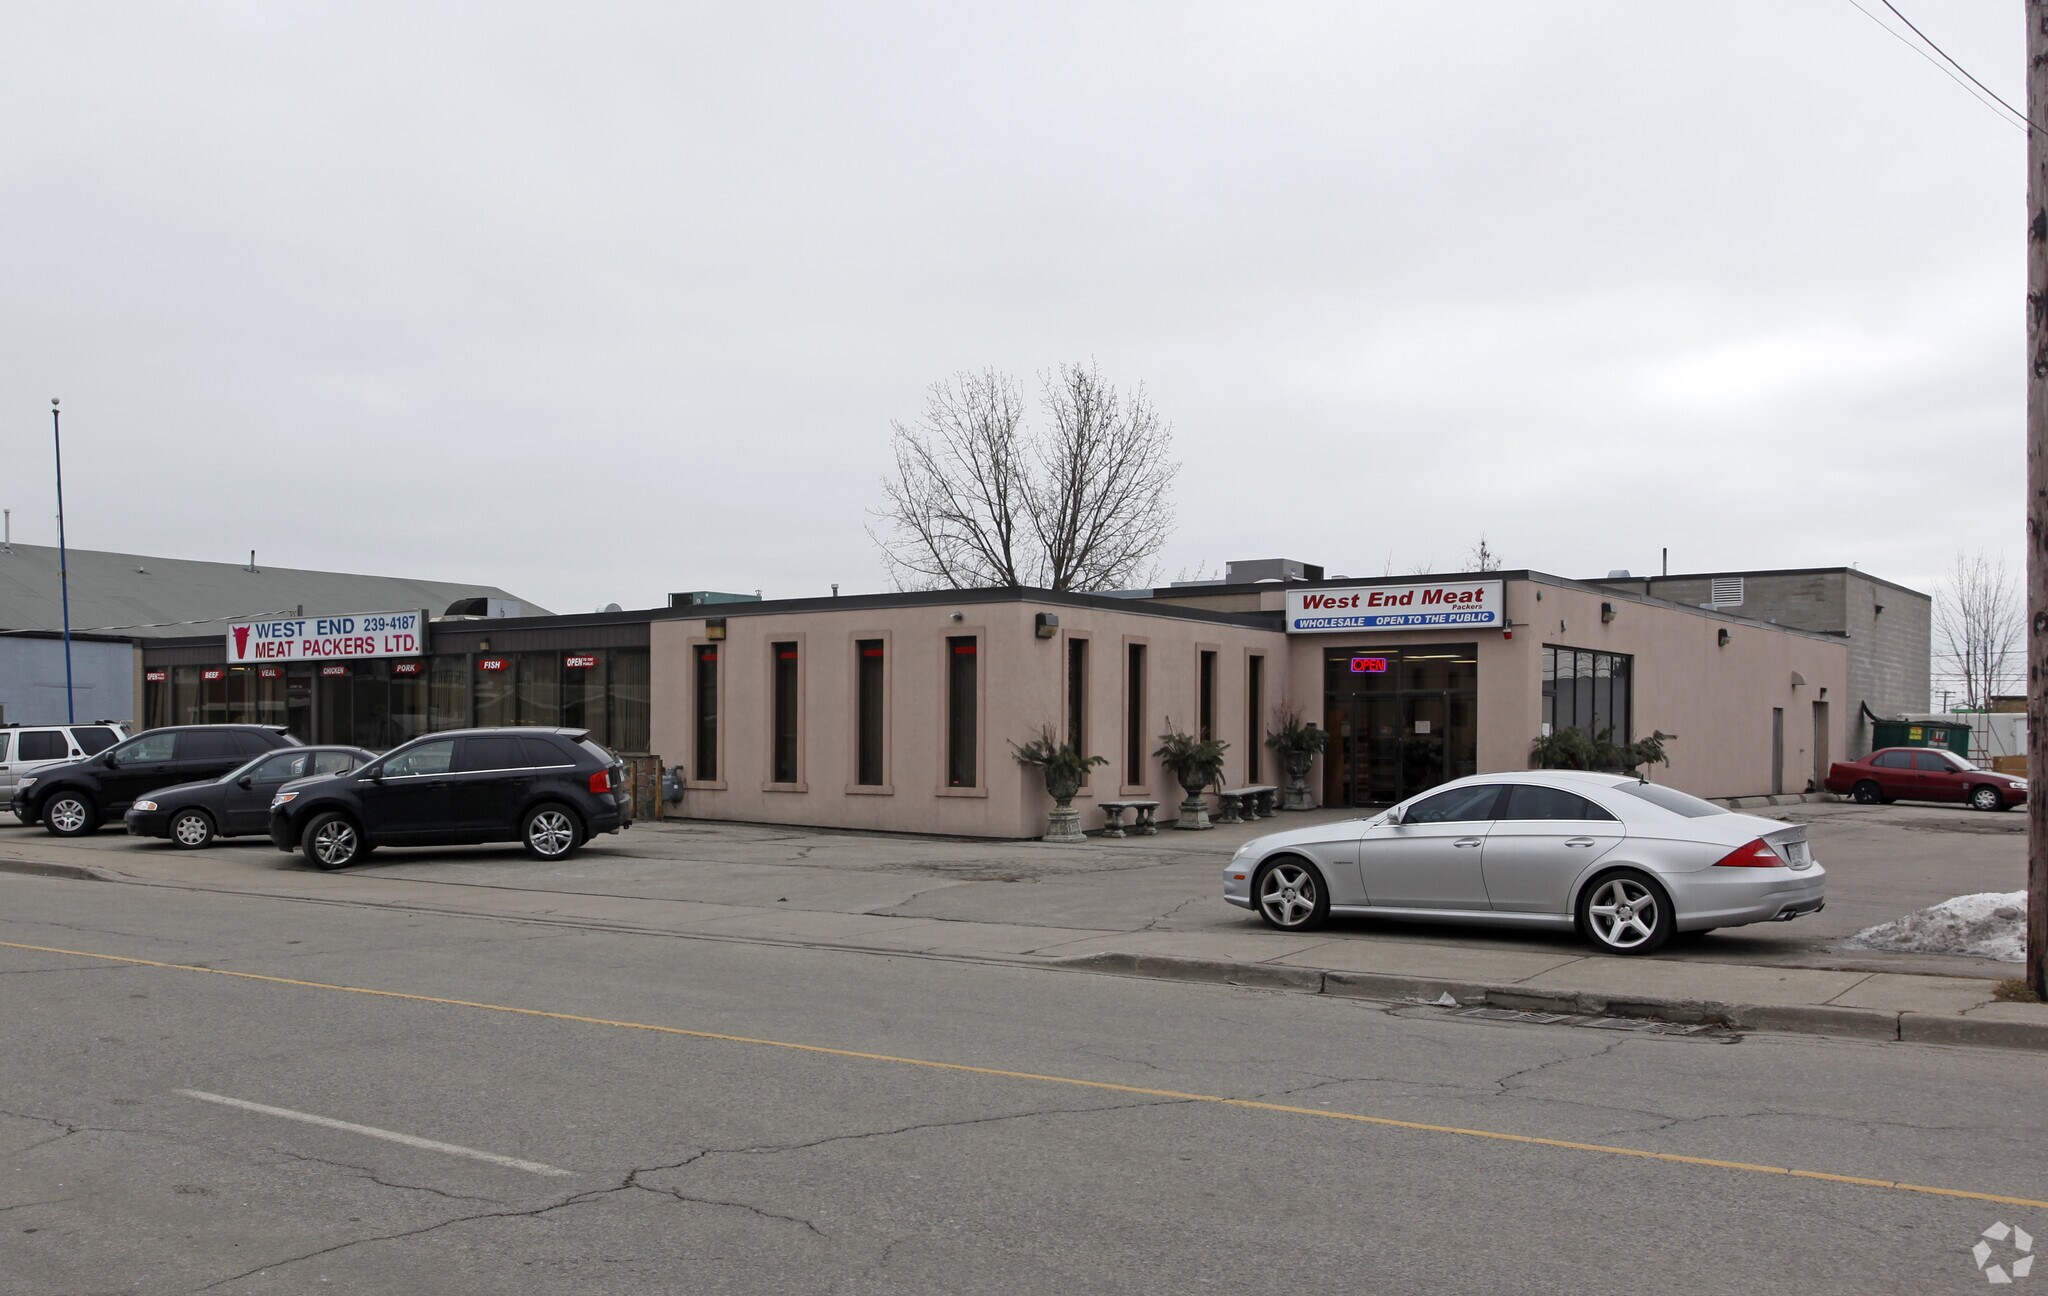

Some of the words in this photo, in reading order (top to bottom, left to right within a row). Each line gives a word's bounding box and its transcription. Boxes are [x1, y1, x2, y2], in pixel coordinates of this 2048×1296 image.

[1302, 593, 1360, 609] West
[1368, 590, 1413, 607] End
[1422, 587, 1484, 604] Meat
[1300, 617, 1364, 628] WHOLESALE
[1376, 615, 1403, 625] OPEN
[1408, 615, 1421, 624] TO
[1425, 614, 1446, 623] THE
[1449, 613, 1489, 622] PUBLIC
[255, 621, 305, 638] WEST
[317, 618, 355, 636] END
[364, 615, 416, 632] 239-4187
[255, 641, 294, 658] MEAT
[302, 636, 375, 657] PACKERS
[385, 634, 419, 653] LTD.
[483, 661, 501, 669] FISH
[567, 658, 582, 666] OPEN
[1353, 660, 1385, 670] OPEN
[323, 667, 345, 675] CHICKEN
[397, 664, 416, 672] PORK
[205, 671, 219, 679] BEEF
[261, 669, 277, 677] VEAL
